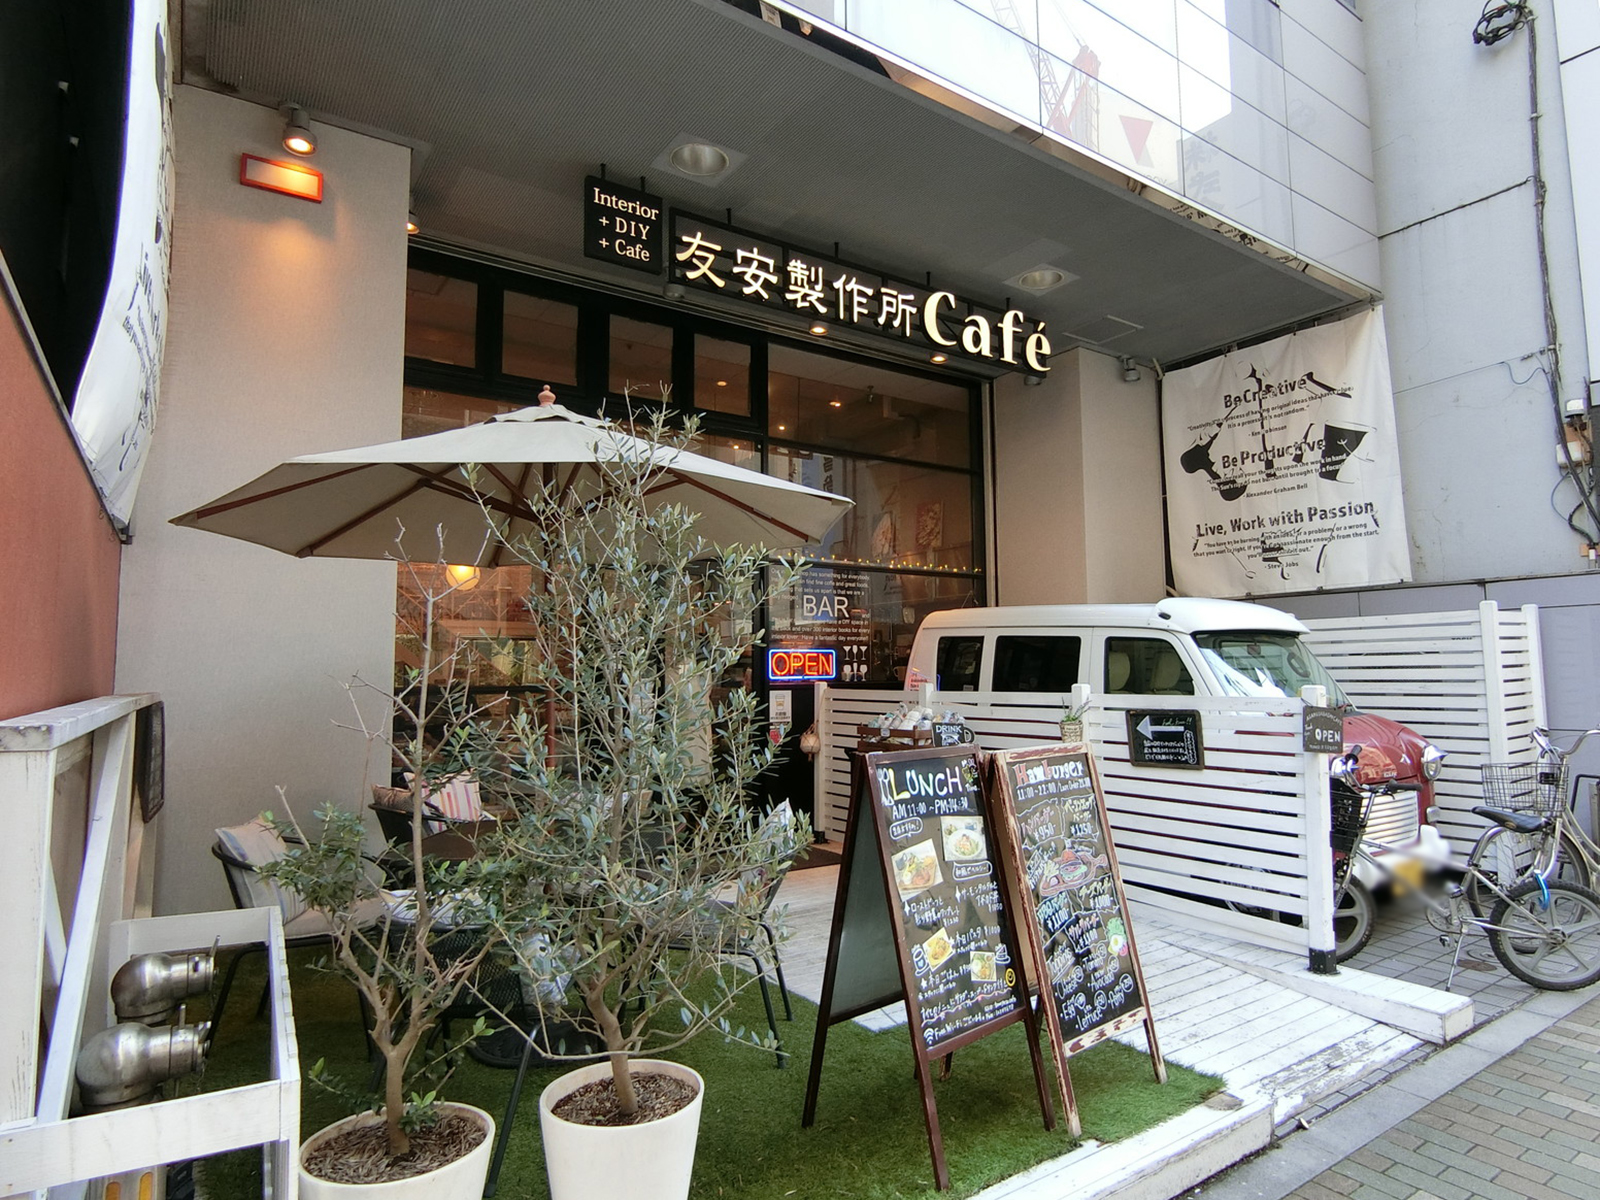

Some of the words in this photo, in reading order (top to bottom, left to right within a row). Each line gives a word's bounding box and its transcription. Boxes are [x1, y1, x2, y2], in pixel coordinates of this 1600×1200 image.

[593, 187, 659, 221] Interior
[615, 216, 650, 240] DIY
[615, 239, 650, 262] Cafe
[675, 231, 917, 338] 友安製作所
[923, 290, 1053, 373] Café
[1224, 394, 1242, 409] Be
[1291, 398, 1308, 407] ideas
[1221, 454, 1238, 469] Be
[1289, 469, 1314, 480] brought
[1196, 523, 1228, 538] Live,
[1230, 516, 1266, 532] Work
[1269, 507, 1304, 527] with
[1307, 501, 1374, 523] Passion
[1348, 522, 1368, 532] wrong
[1336, 533, 1351, 541] from
[1352, 531, 1362, 539] the
[803, 594, 850, 618] BAR
[771, 652, 833, 675] OPEN
[935, 725, 962, 734] DRINK
[1315, 728, 1341, 742] OPEN
[888, 765, 963, 801] LUNCH
[1012, 759, 1085, 788] Hamburger
